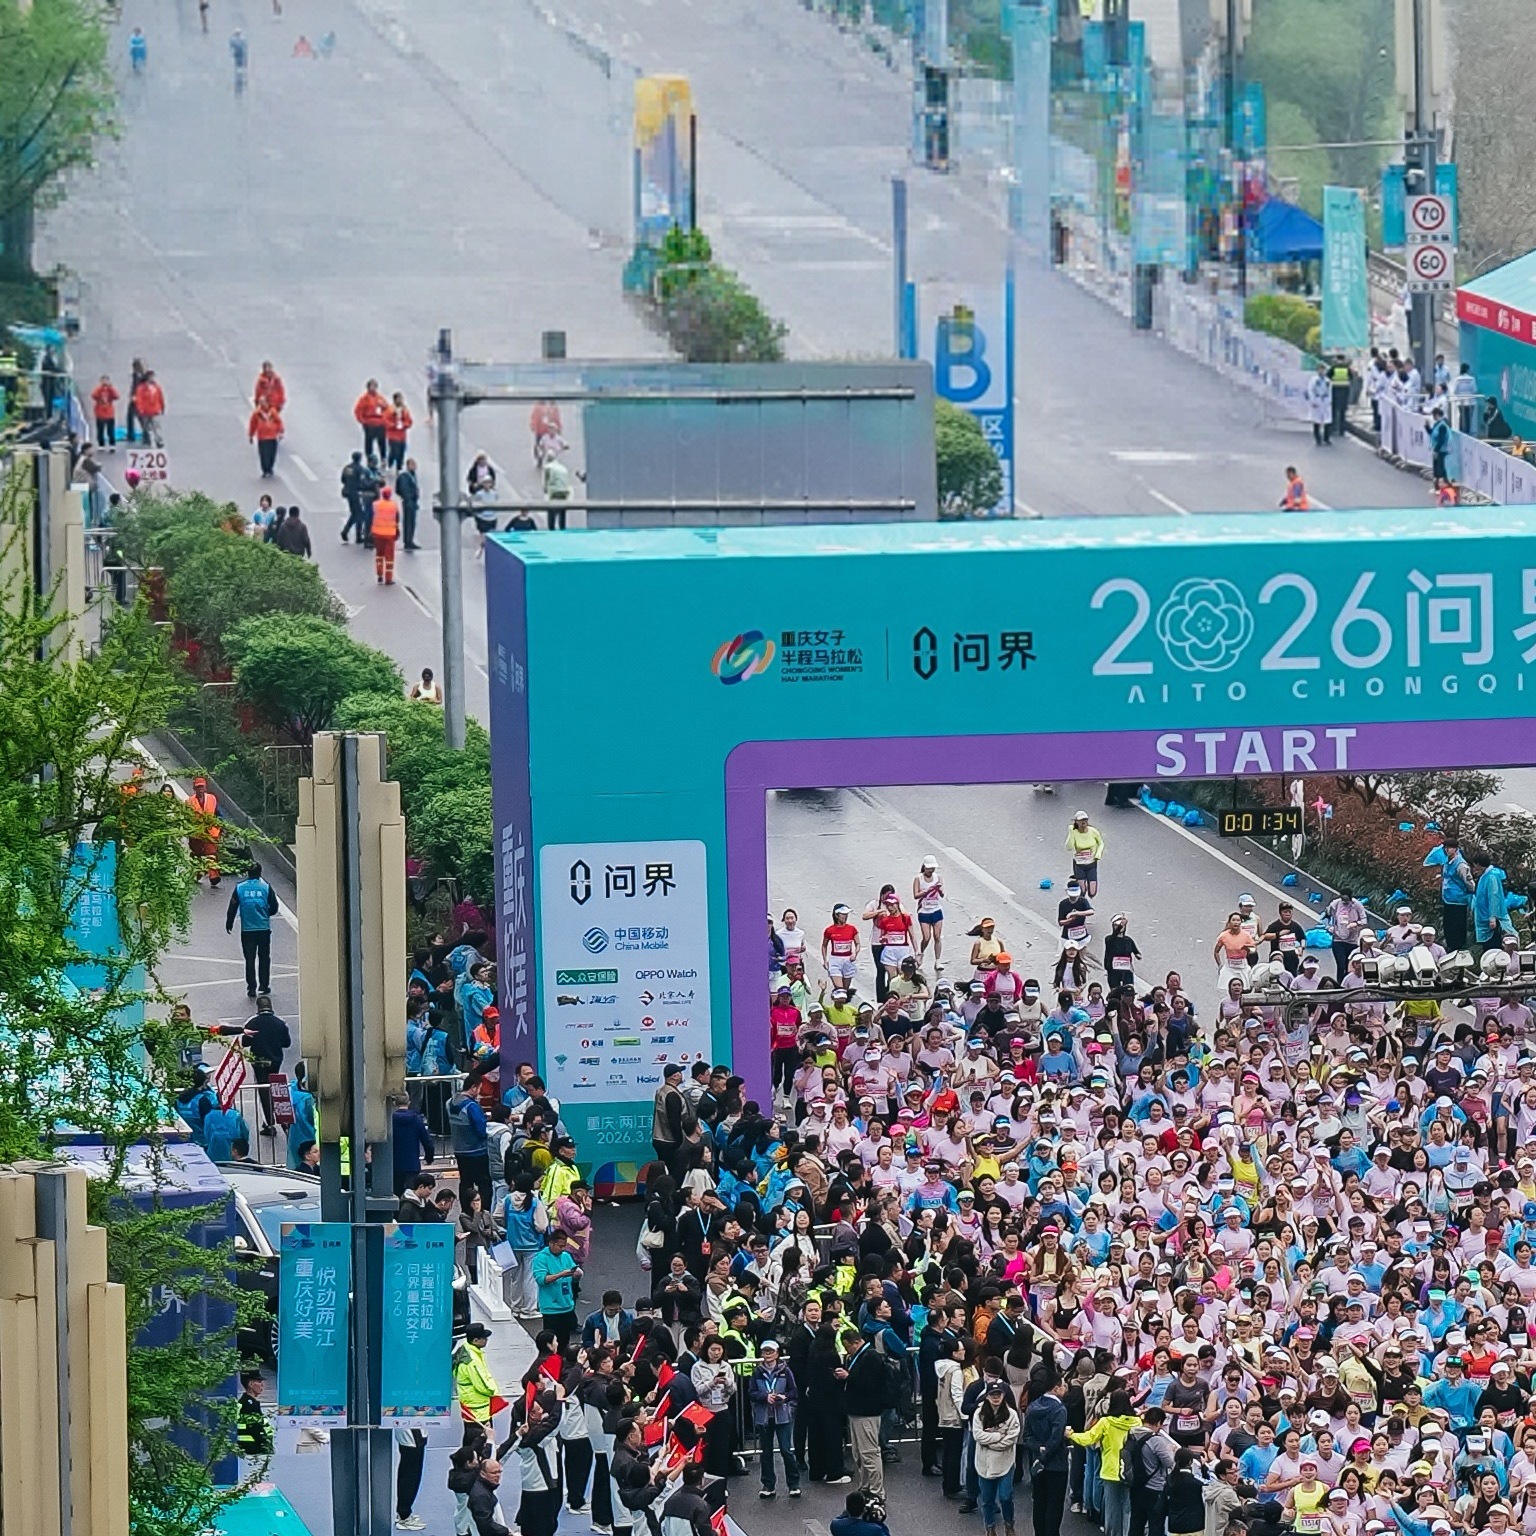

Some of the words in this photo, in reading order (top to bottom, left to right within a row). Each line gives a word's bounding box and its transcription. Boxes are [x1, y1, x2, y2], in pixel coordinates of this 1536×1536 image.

[1420, 207, 1440, 222] 70
[1420, 255, 1440, 270] 60
[130, 453, 166, 468] 7:20
[781, 630, 846, 647] 重庆女子
[781, 649, 863, 666] 半程马拉松
[953, 632, 1037, 672] 问界
[1128, 682, 1247, 704] AITO
[1155, 727, 1357, 777] START
[606, 864, 676, 898] 问界
[615, 927, 669, 940] 中国移动
[641, 942, 669, 950] Mobile
[577, 971, 616, 983] 众安保险
[636, 970, 664, 979] OPPO
[667, 969, 697, 978] Watch
[597, 1131, 652, 1144] 2026.3.
[294, 1258, 314, 1340] 重庆好美
[406, 1263, 420, 1344] 问界重庆女子
[420, 1263, 434, 1330] 半程马拉松
[315, 1266, 336, 1347] 悦动两江
